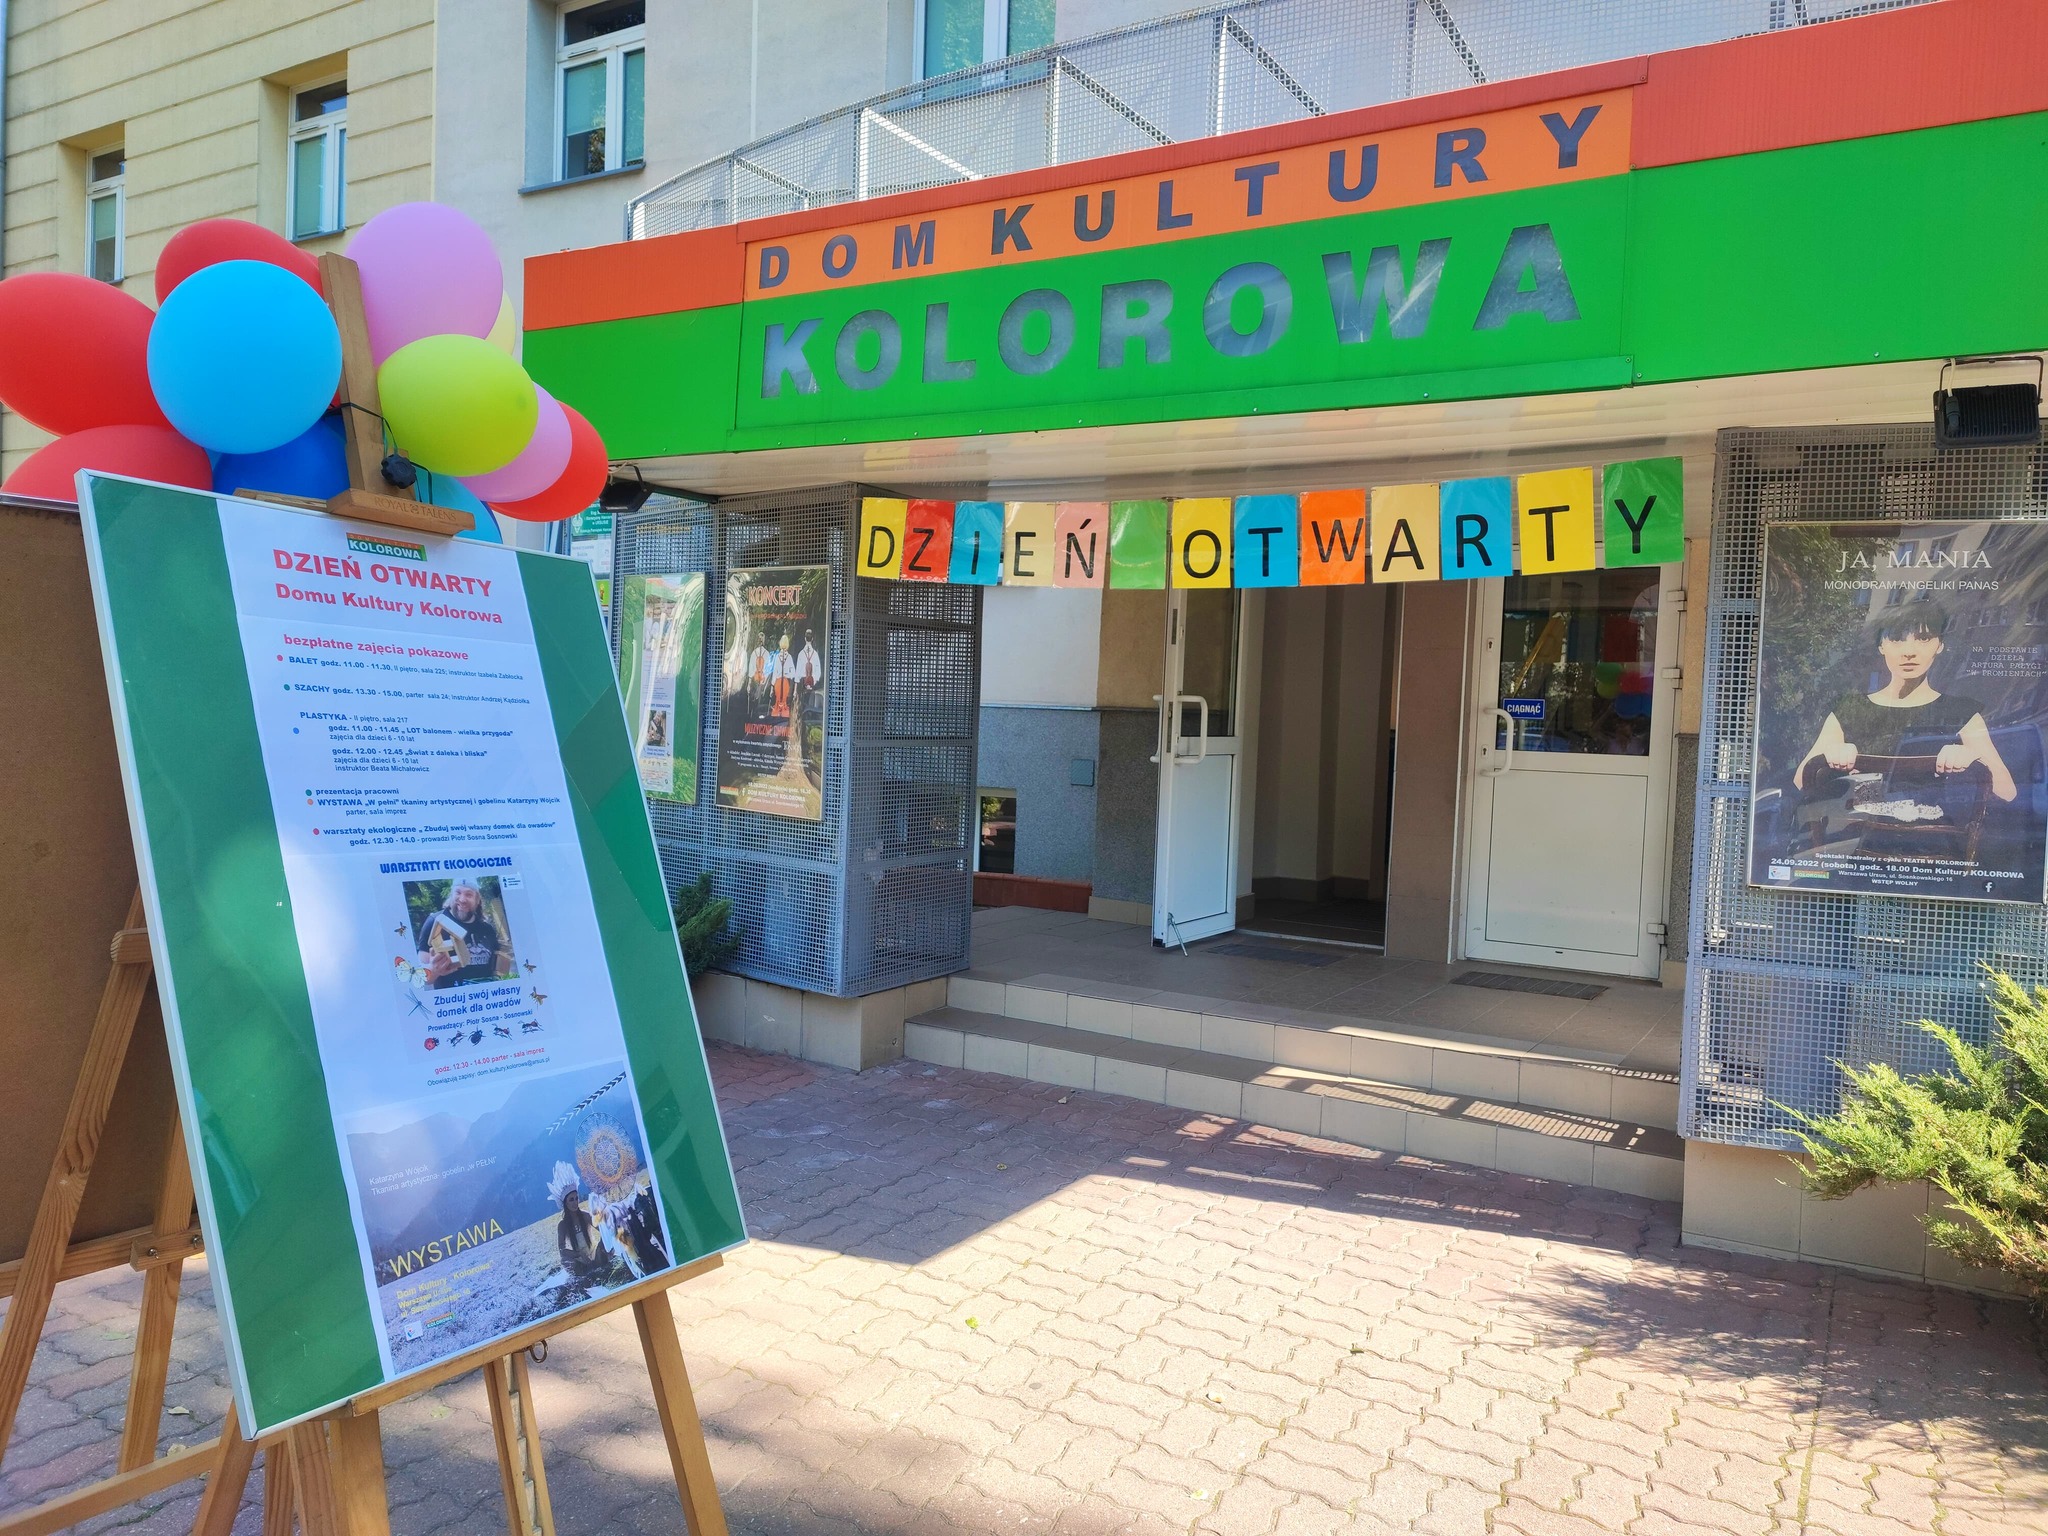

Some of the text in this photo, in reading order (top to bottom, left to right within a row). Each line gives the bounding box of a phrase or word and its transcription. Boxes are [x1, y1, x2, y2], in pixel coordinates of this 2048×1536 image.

[759, 104, 1603, 289] DOM KULTURY
[761, 222, 1582, 399] KOLOROWA
[374, 496, 456, 521] ROYAL TALENS
[867, 495, 1657, 579] DZIEŃ OTWARTY
[349, 540, 421, 559] KOLOROWA
[1836, 550, 1993, 573] JA, MANIA
[273, 549, 491, 597] DZIEŃ OTWARTY
[748, 585, 802, 606] KONCERT
[1824, 581, 1999, 590] MONODRAM ANGELIKI PANAS
[275, 583, 502, 624] Domu Kultury Kolorowa
[284, 634, 468, 660] bezpłatne zajęcia pokazowe
[1989, 646, 2038, 654] PODSTAWIE
[289, 656, 318, 665] BALET
[321, 659, 341, 667] godz.
[448, 669, 476, 677] instruktor
[294, 683, 330, 692] SZACHY
[481, 695, 502, 704] Andrzej
[300, 711, 347, 721] PLASTYKA
[1507, 703, 1541, 715] CIĄGNĄĆ
[330, 734, 354, 742] zajęcia
[422, 727, 452, 735] balonem
[316, 788, 399, 796] prezentacja pracowni
[401, 799, 428, 807] tkaniny
[430, 798, 473, 806] artystycznej
[478, 797, 506, 805] gobelinu
[507, 797, 538, 805] Katarzyny
[384, 808, 407, 816] imprez
[323, 827, 365, 836] warsztaty
[367, 826, 416, 835] ekologiczne
[493, 822, 515, 830] domek
[349, 838, 370, 846] godz.
[373, 837, 394, 845] 12.30
[421, 835, 449, 843] prowadzi
[380, 856, 512, 874] WARSZTATY EKOLOGICZNE
[1771, 857, 1818, 867] 24.09.2022
[1821, 860, 1857, 870] (sobota)
[1860, 864, 1883, 872] godz.
[1935, 867, 1968, 877] Kultury
[1970, 869, 2024, 879] KOLOROWA
[1815, 852, 1844, 860] Spektakl
[1846, 854, 1876, 862] teatralny
[1935, 859, 1979, 867] KOLOROWEJ
[434, 985, 520, 1006] Zbuduj swój własny
[436, 997, 522, 1018] domek dla owadów
[427, 1009, 533, 1032] Prowadzący: Piotr Sosna Sosnowski
[434, 1047, 545, 1075] godz. 12.30 14.00 parter sala imprez
[427, 1076, 458, 1087] Obowiązują
[369, 1164, 429, 1186] Katarzyna Wójcik
[371, 1183, 399, 1196] Tkanina
[441, 1165, 465, 1179] gobelin
[389, 1218, 504, 1278] WYSTAWA
[396, 1287, 416, 1299] Dom
[419, 1278, 447, 1292] Kultury
